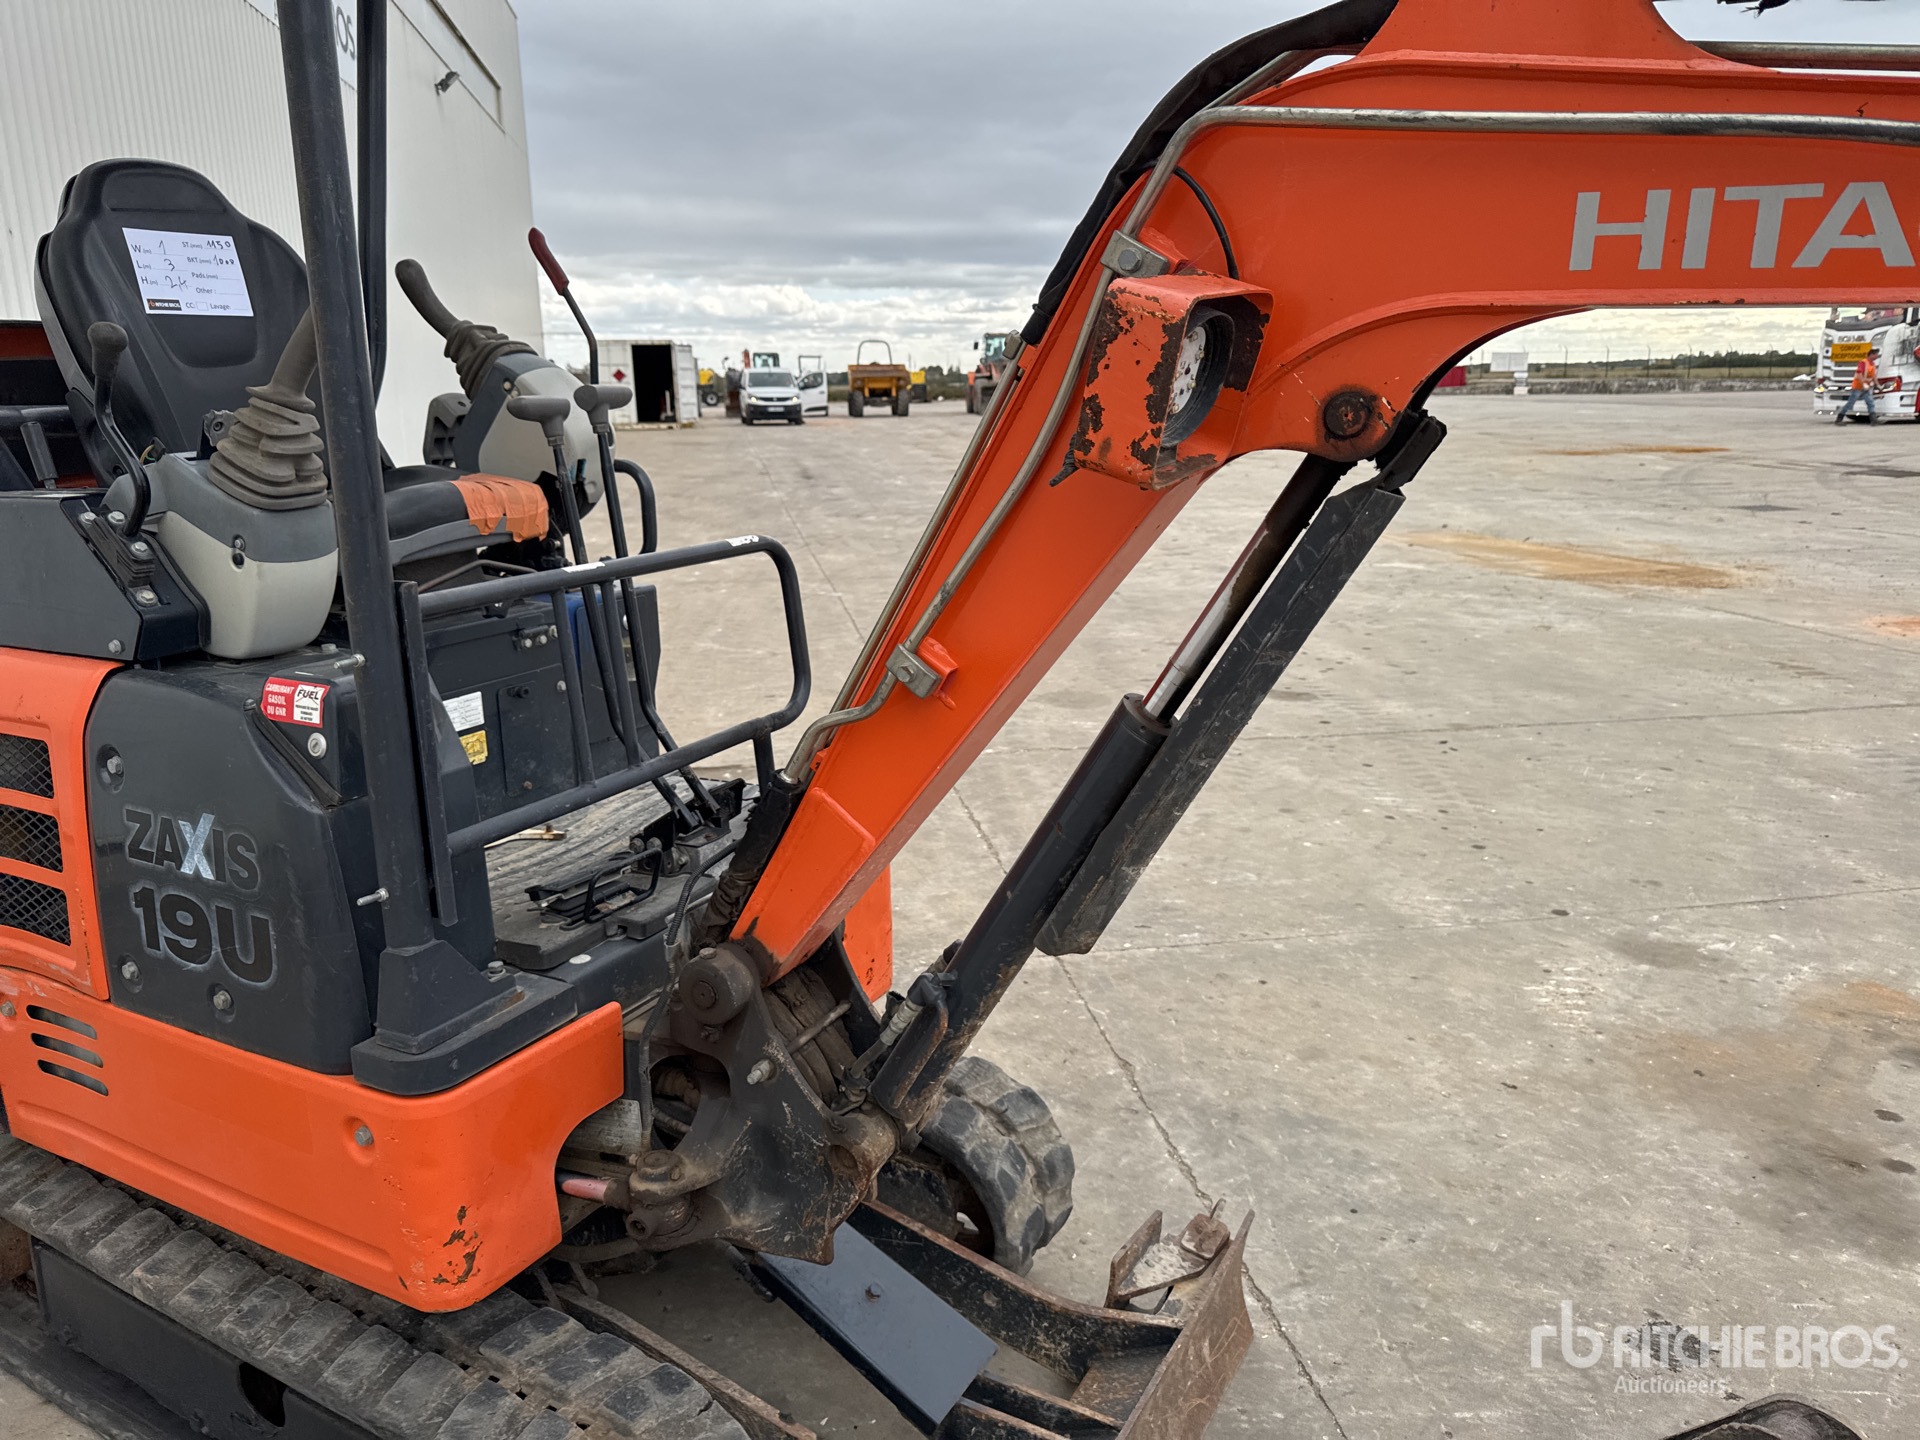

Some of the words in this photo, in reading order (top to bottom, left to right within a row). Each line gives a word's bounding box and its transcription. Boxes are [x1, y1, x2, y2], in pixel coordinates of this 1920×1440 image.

[333, 5, 356, 61] OS
[1569, 181, 1920, 271] HITA
[206, 239, 231, 250] 1150
[164, 259, 175, 271] 3
[268, 695, 286, 705] GASOIL
[297, 689, 319, 700] FUEL
[267, 705, 274, 714] OU
[276, 707, 286, 716] GNR
[124, 808, 259, 891] ZAXIS
[133, 886, 274, 983] 19U
